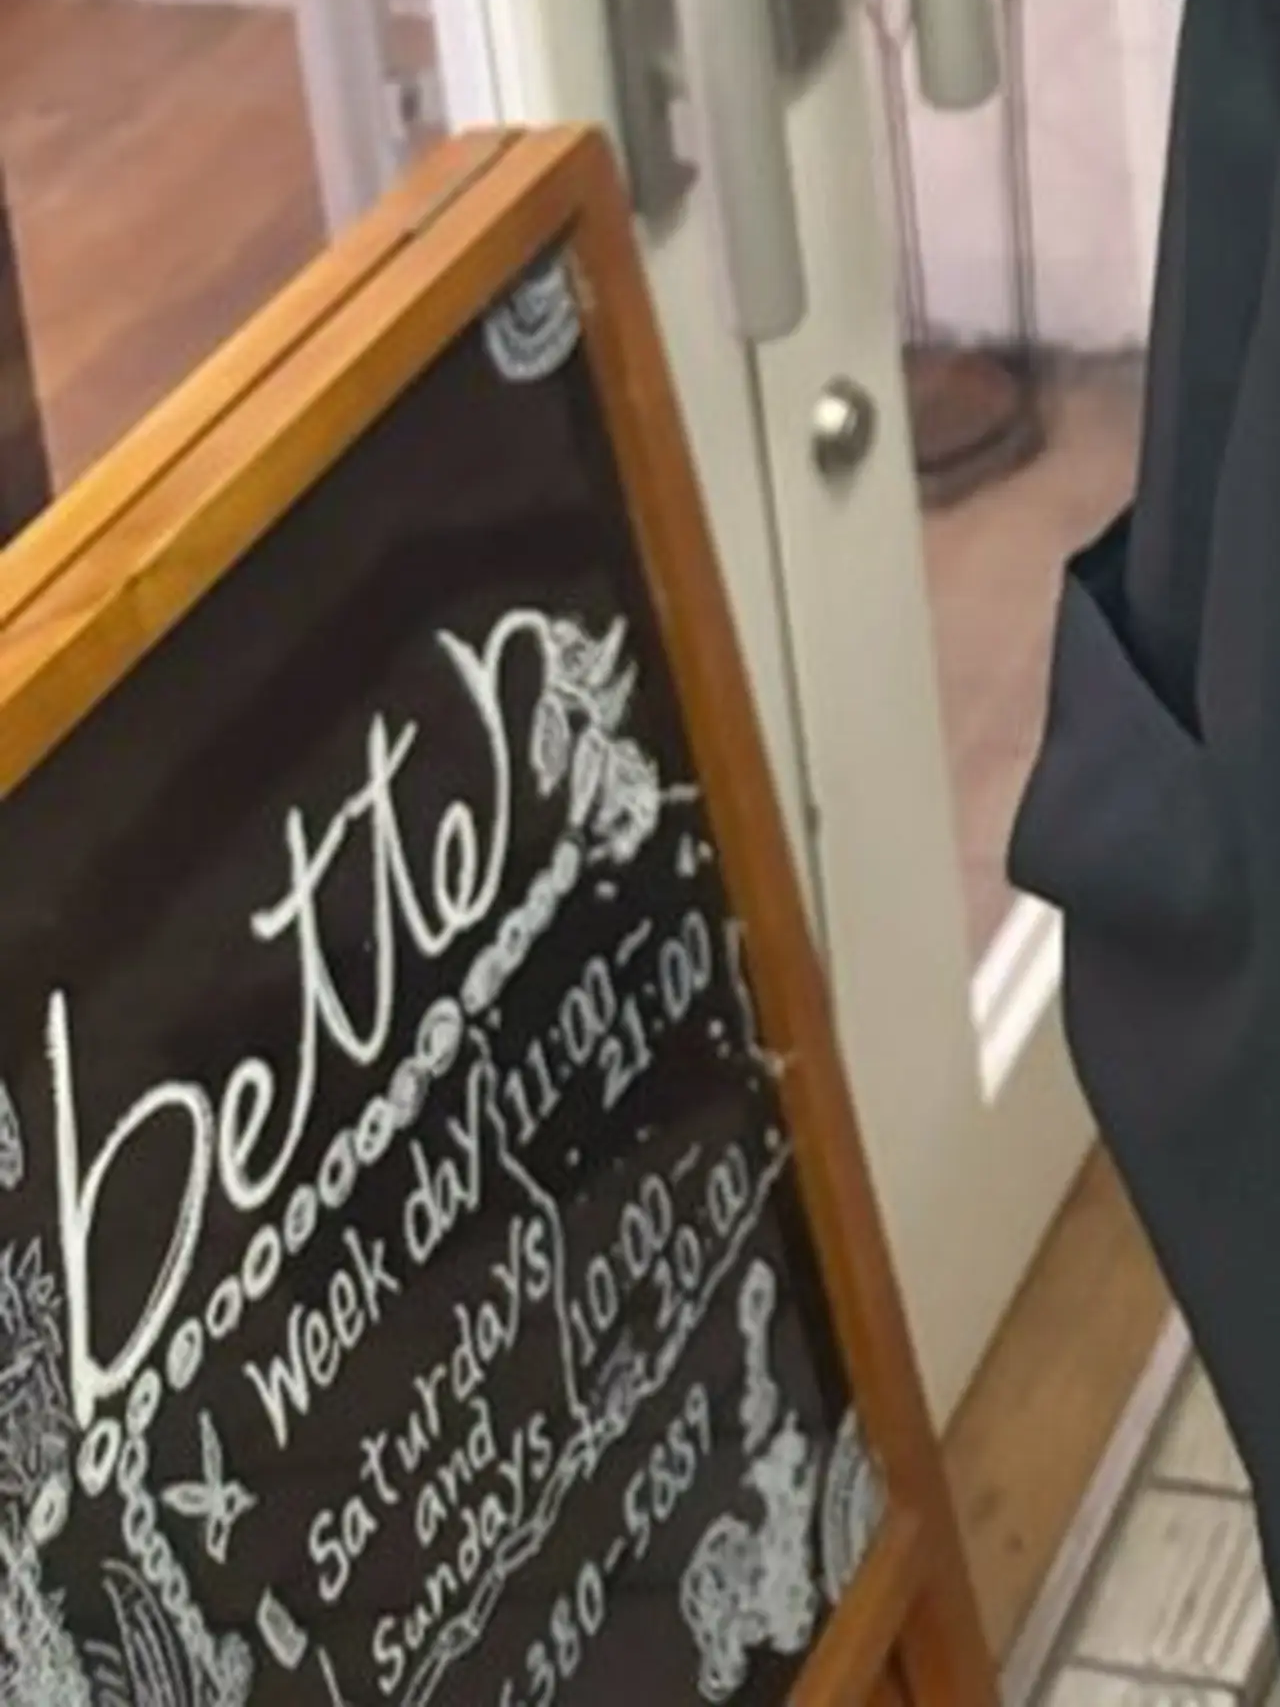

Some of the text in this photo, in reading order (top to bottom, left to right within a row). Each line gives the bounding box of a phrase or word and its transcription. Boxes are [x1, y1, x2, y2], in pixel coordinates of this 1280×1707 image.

[47, 609, 556, 1427] better
[598, 909, 712, 1110] 21:00
[308, 1216, 552, 1603] Saturdays
[414, 1395, 497, 1548] and
[372, 1411, 552, 1696] Sundays
